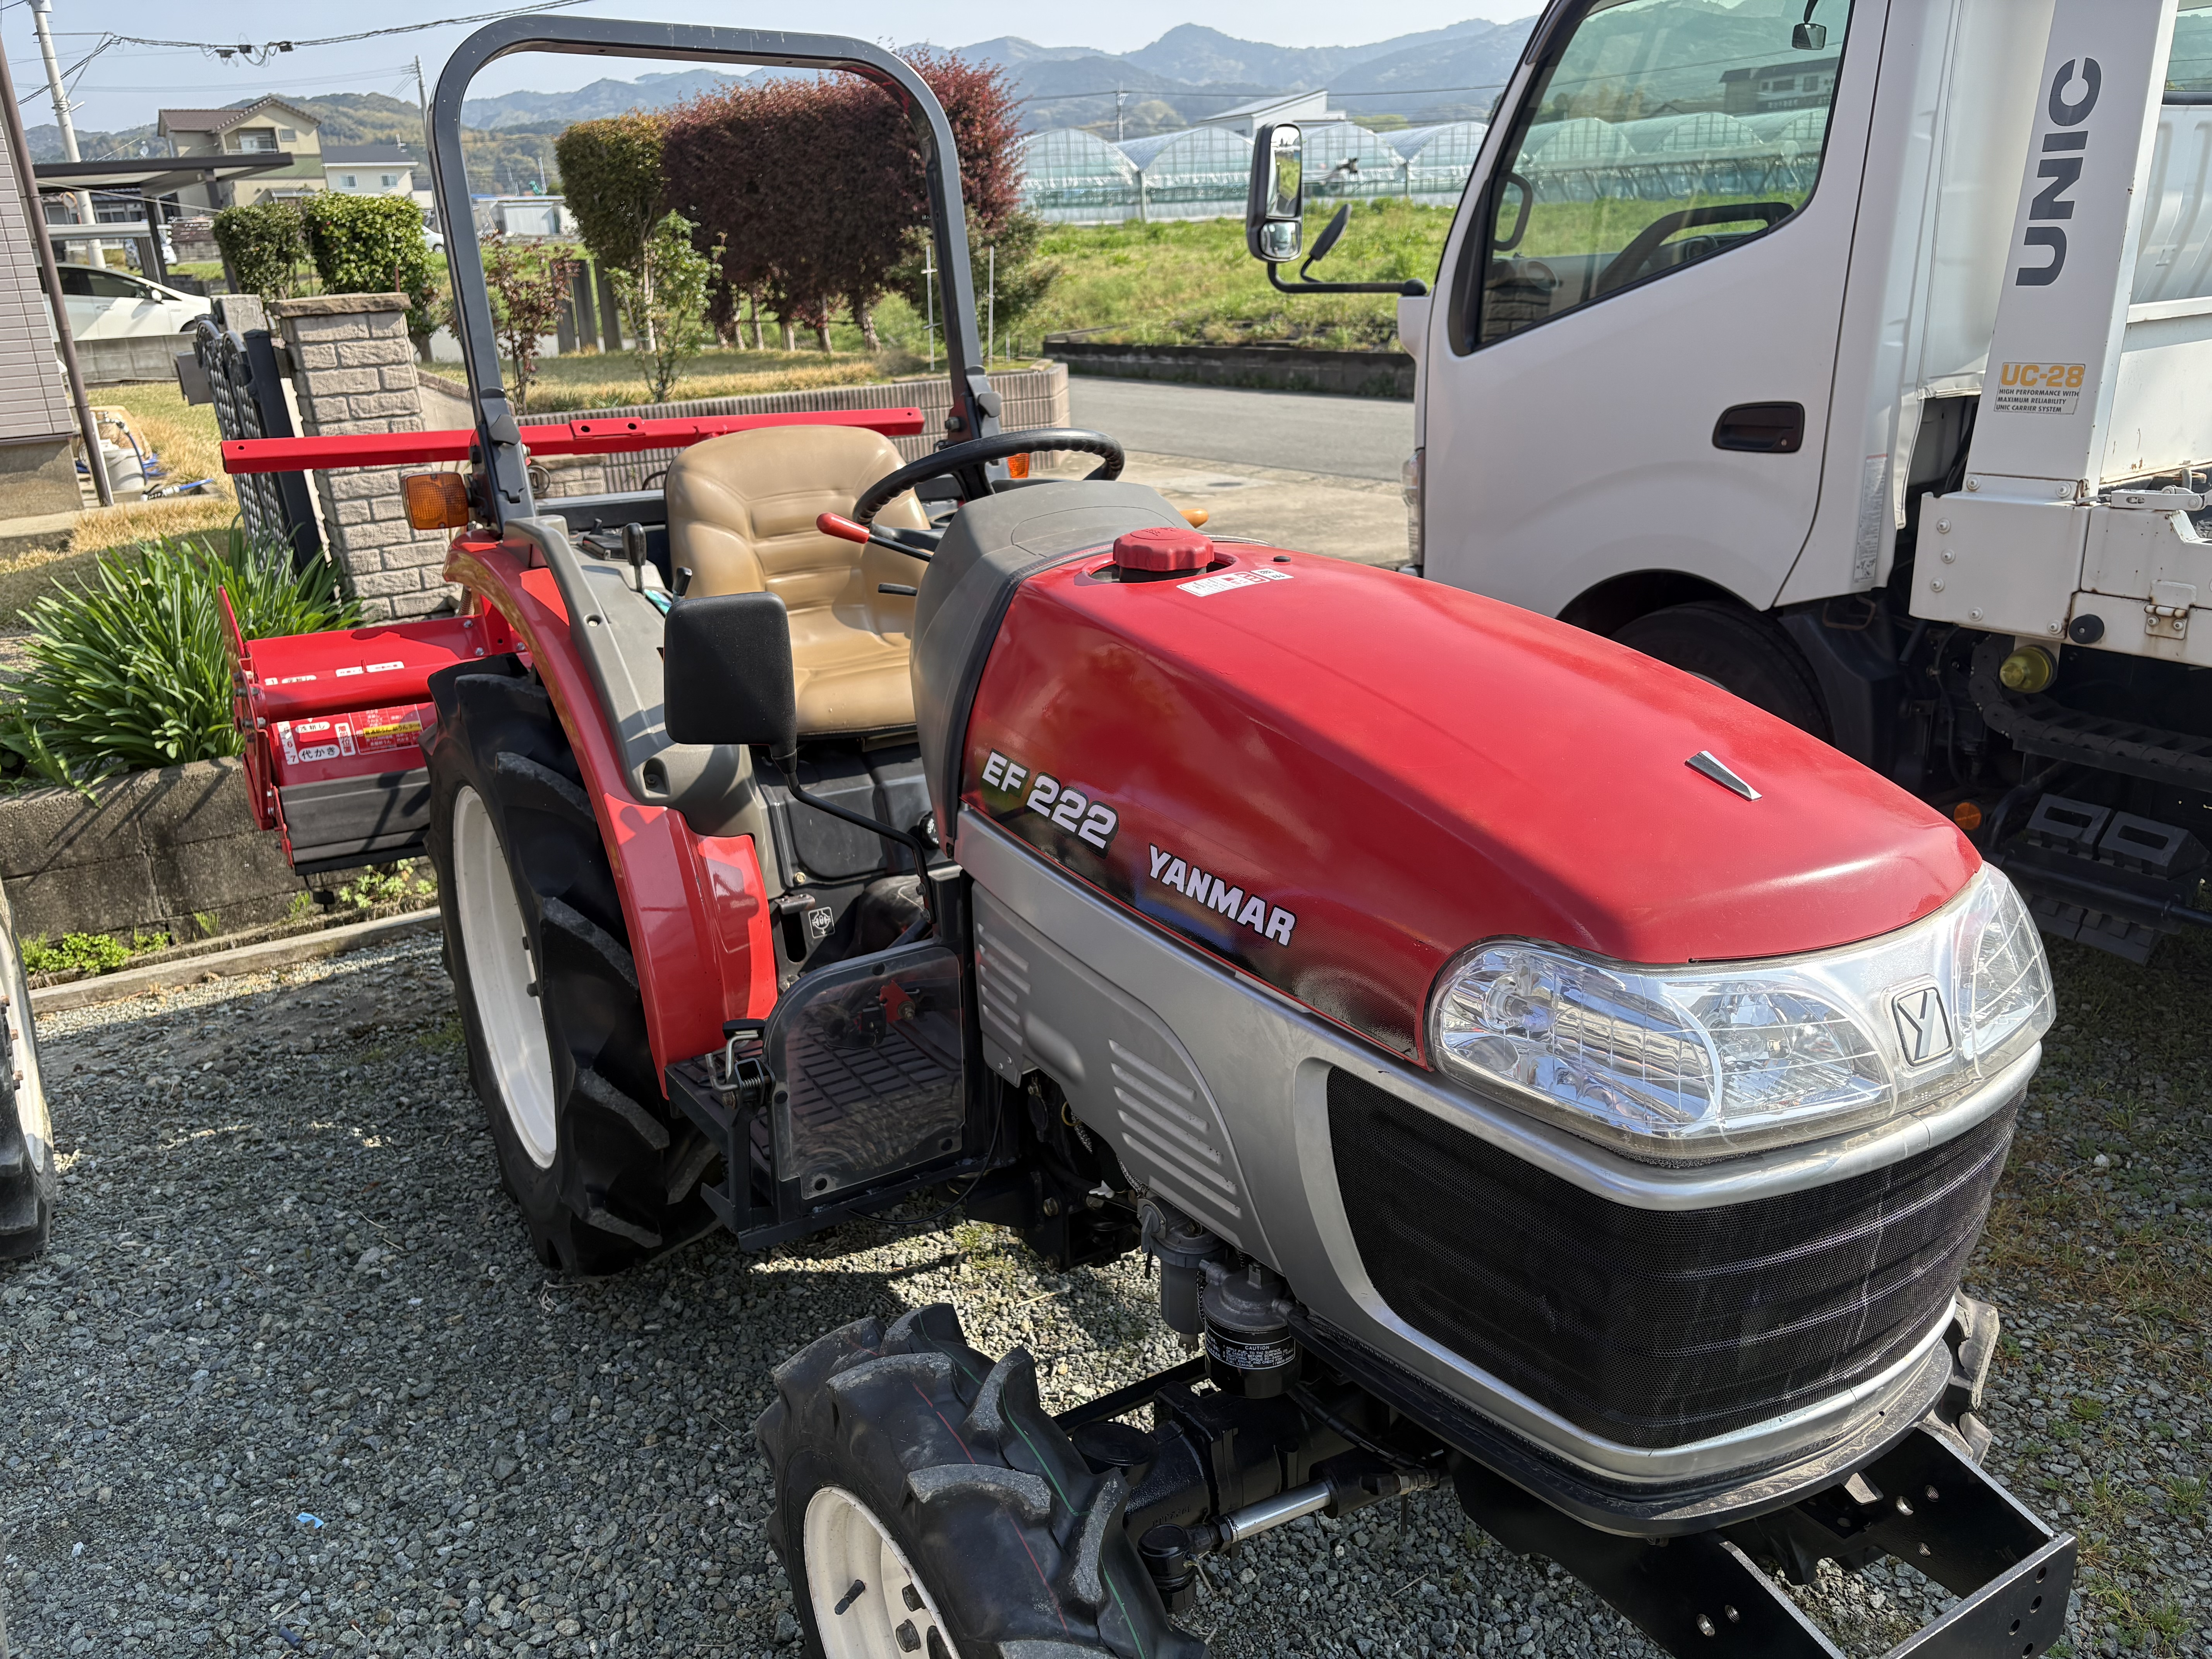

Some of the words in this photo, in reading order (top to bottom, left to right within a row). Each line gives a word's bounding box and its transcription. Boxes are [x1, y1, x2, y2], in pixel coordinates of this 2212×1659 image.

[2016, 58, 2101, 286] UNIC
[2001, 364, 2084, 388] UC-28
[302, 747, 335, 760] 代かき
[982, 752, 1027, 791] EF
[1026, 776, 1117, 849] 222
[1149, 845, 1295, 946] YANMAR
